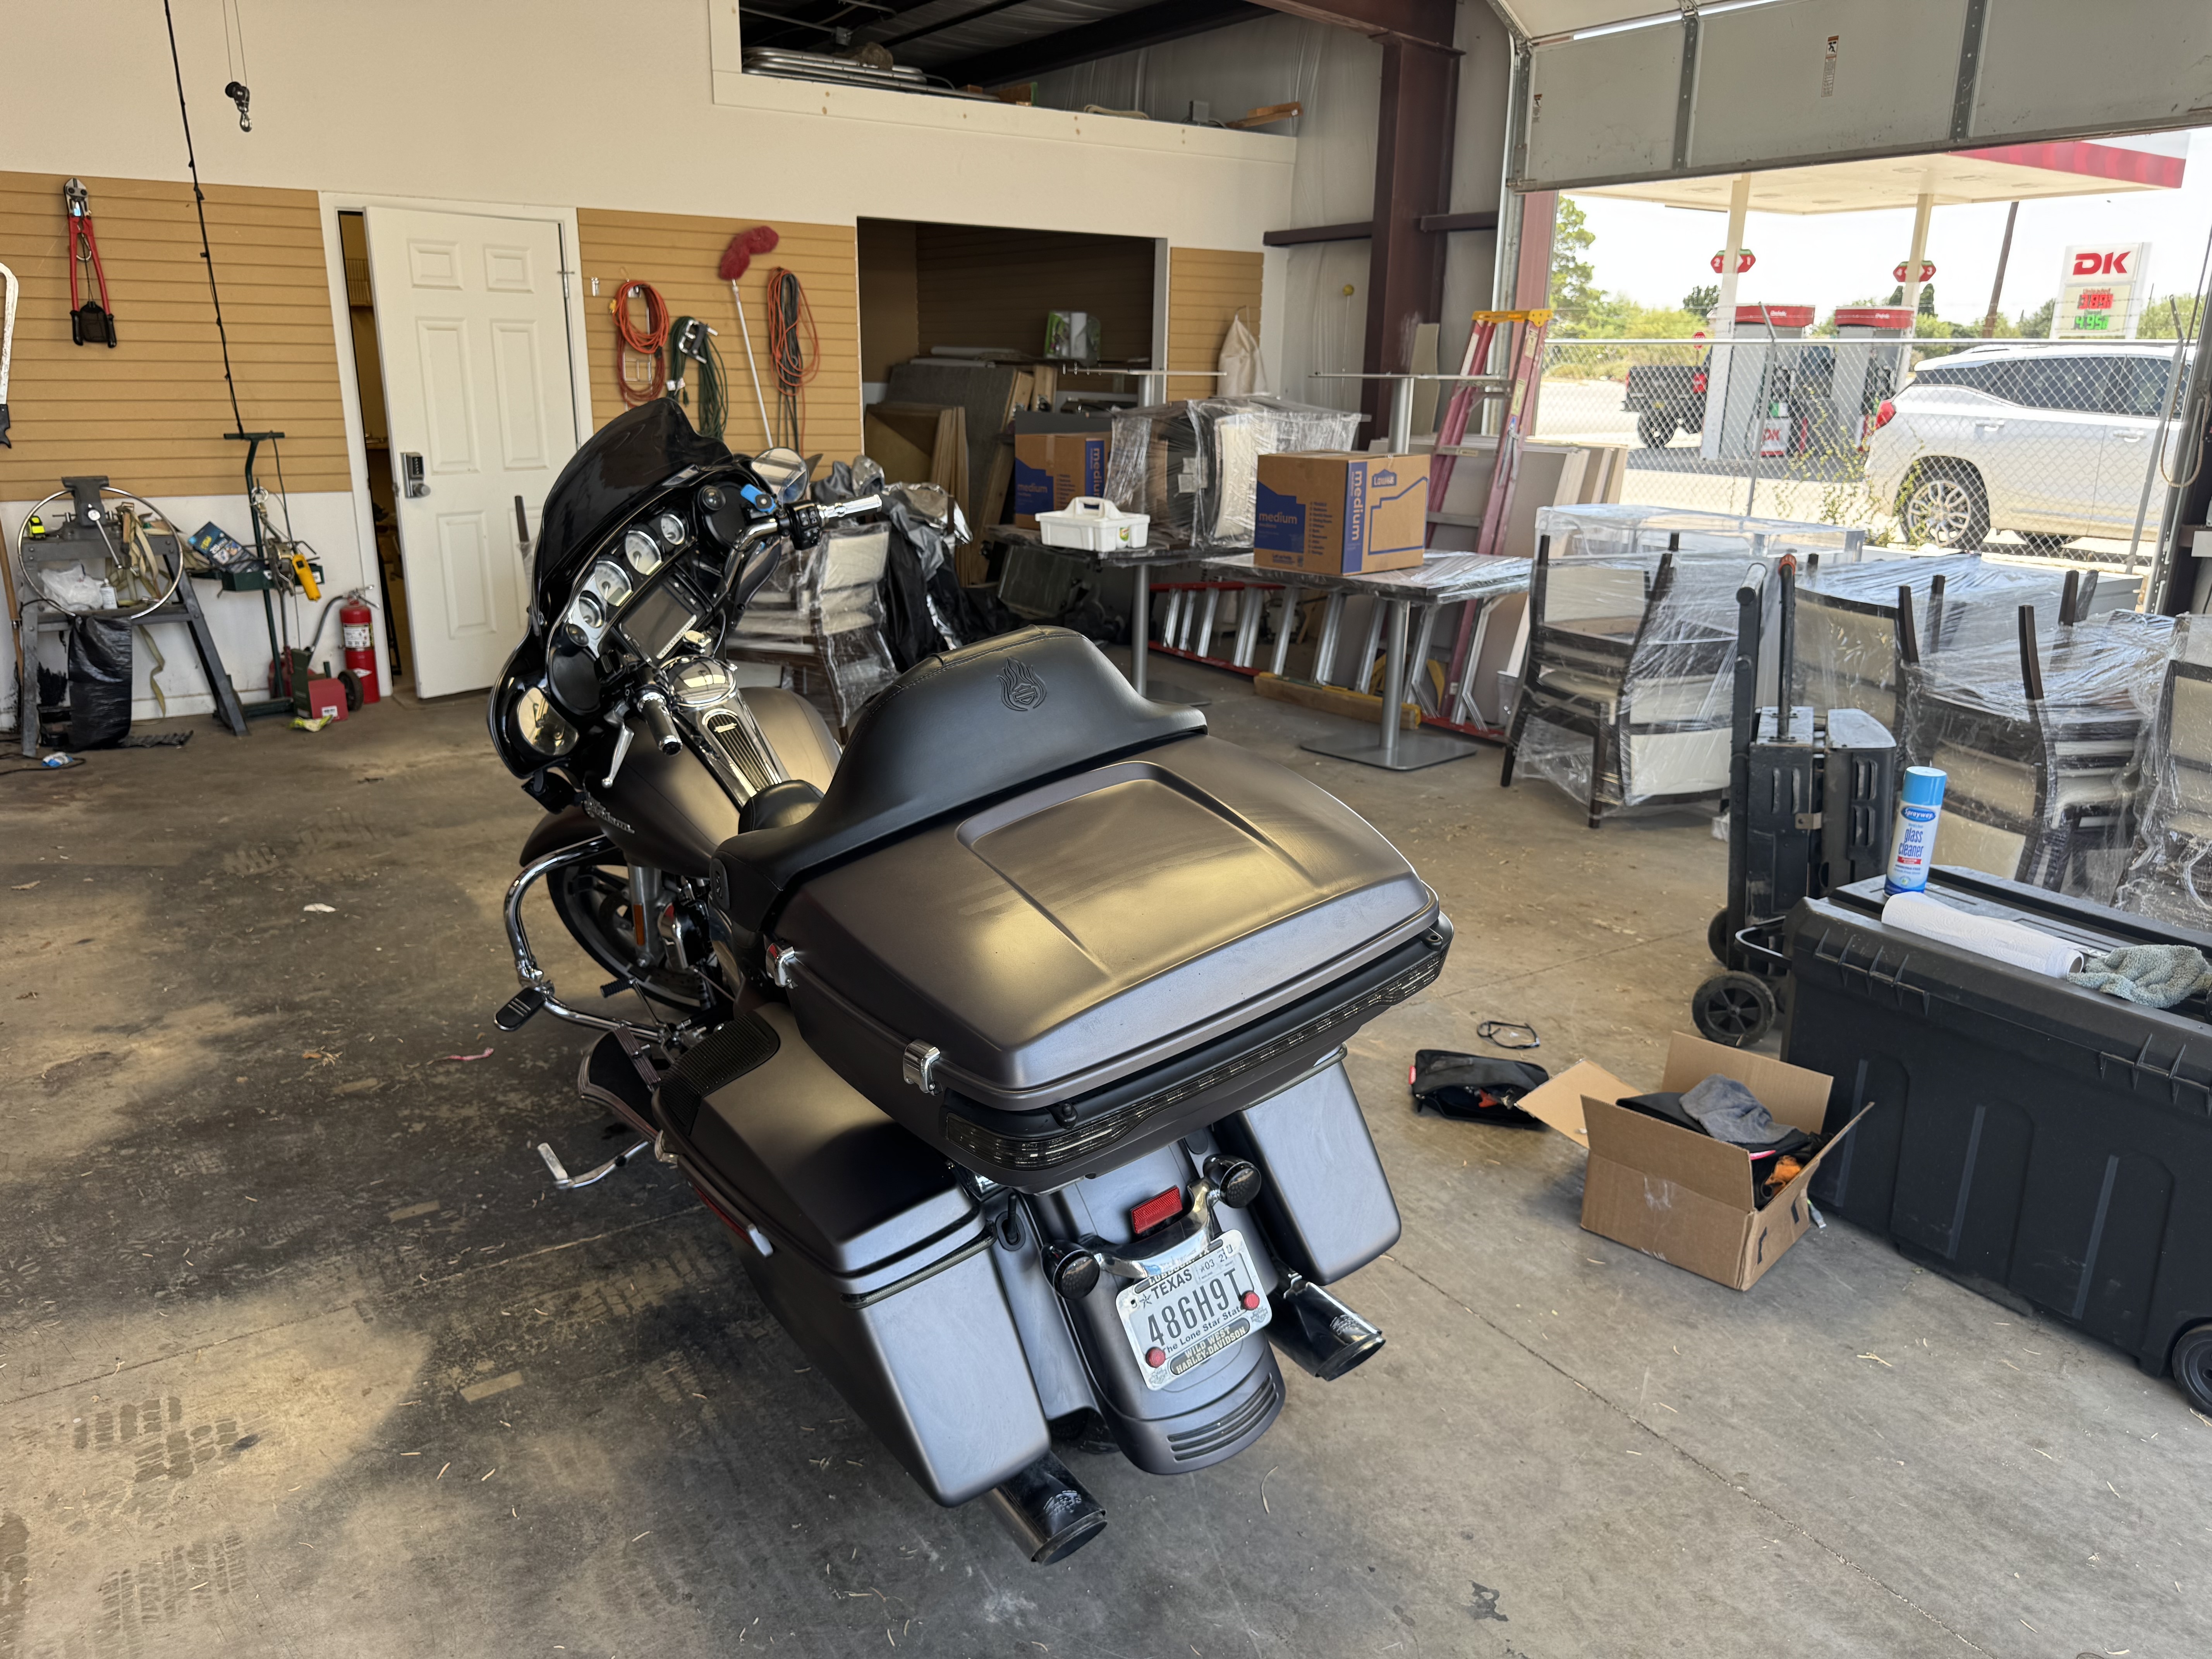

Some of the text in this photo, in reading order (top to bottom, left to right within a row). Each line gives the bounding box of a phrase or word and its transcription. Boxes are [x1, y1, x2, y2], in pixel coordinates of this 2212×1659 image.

[1714, 258, 1720, 267] 2
[1747, 256, 1751, 265] 1
[2073, 251, 2131, 275] DK
[1927, 266, 1932, 275] 3
[1018, 483, 1048, 493] medium
[1352, 471, 1363, 541] medium
[1259, 511, 1297, 524] medium
[1904, 807, 1933, 819] Sprayway
[1904, 827, 1923, 843] glass
[1898, 842, 1923, 857] cleaner
[1205, 1259, 1215, 1270] 03
[1151, 1269, 1192, 1299] TEXAS
[1148, 1267, 1241, 1346] 486H9T
[1181, 1331, 1200, 1346] Lone
[1202, 1319, 1220, 1331] Star
[1185, 1326, 1230, 1358] WILD WEST
[1176, 1326, 1246, 1374] HARLEY-DAVIDSON
